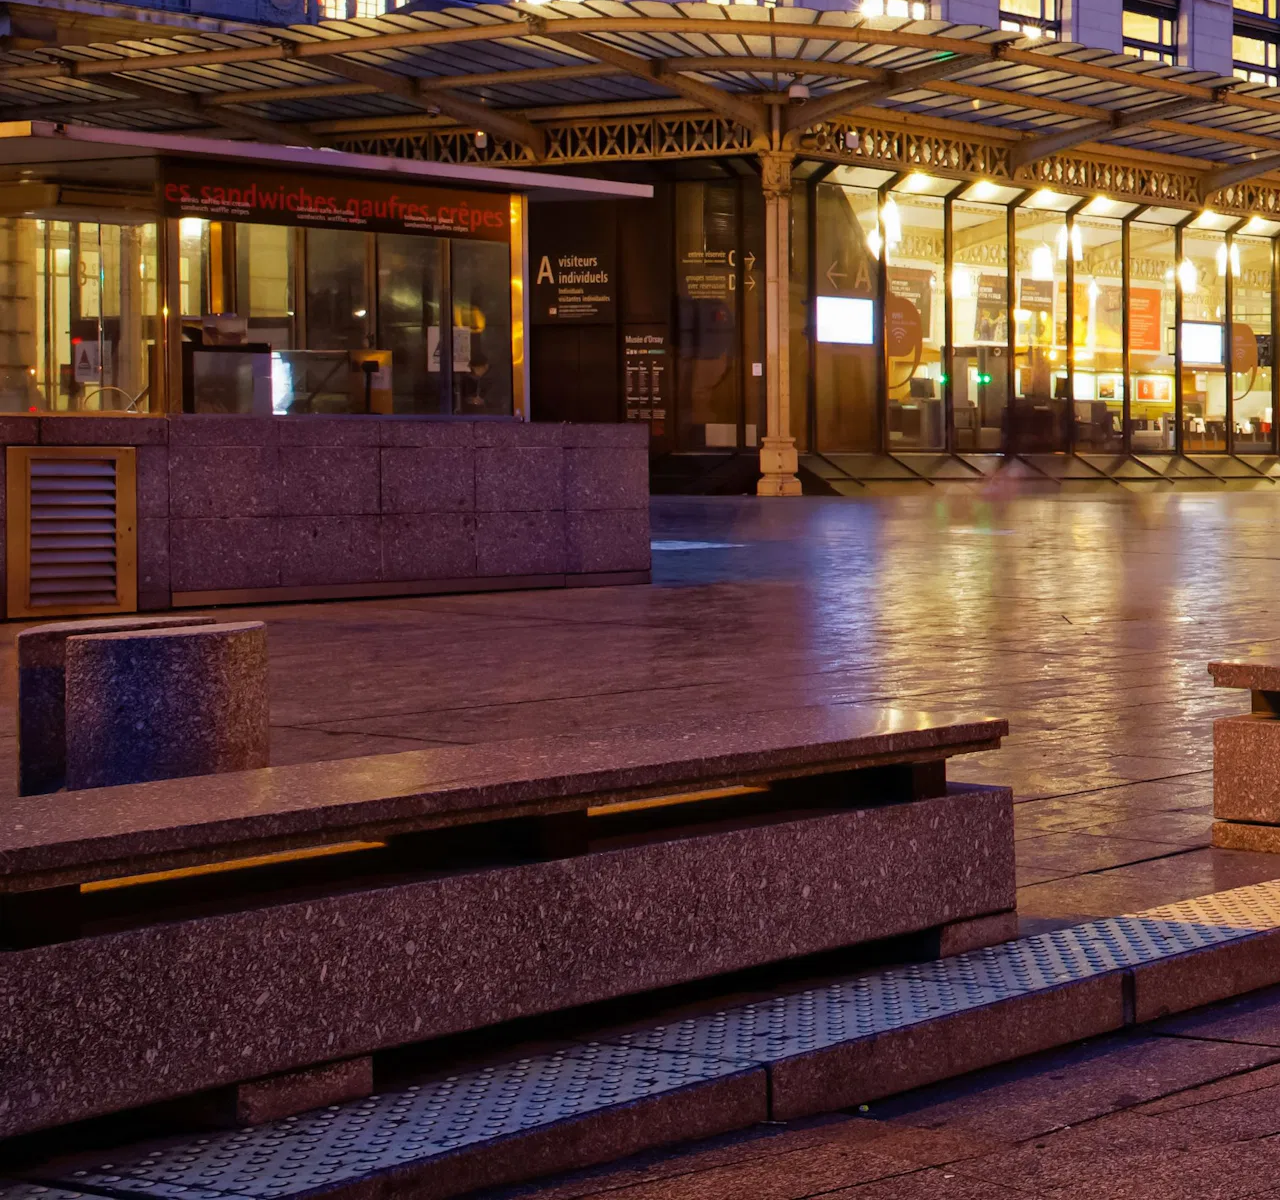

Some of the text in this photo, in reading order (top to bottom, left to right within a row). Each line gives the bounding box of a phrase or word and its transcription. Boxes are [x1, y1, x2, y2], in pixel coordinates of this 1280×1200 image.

[200, 183, 336, 212] sandwiches
[346, 195, 429, 221] gaufres
[438, 200, 504, 231] crêpes
[537, 255, 554, 285] A
[558, 254, 598, 268] visiteurs
[558, 271, 609, 284] individuels
